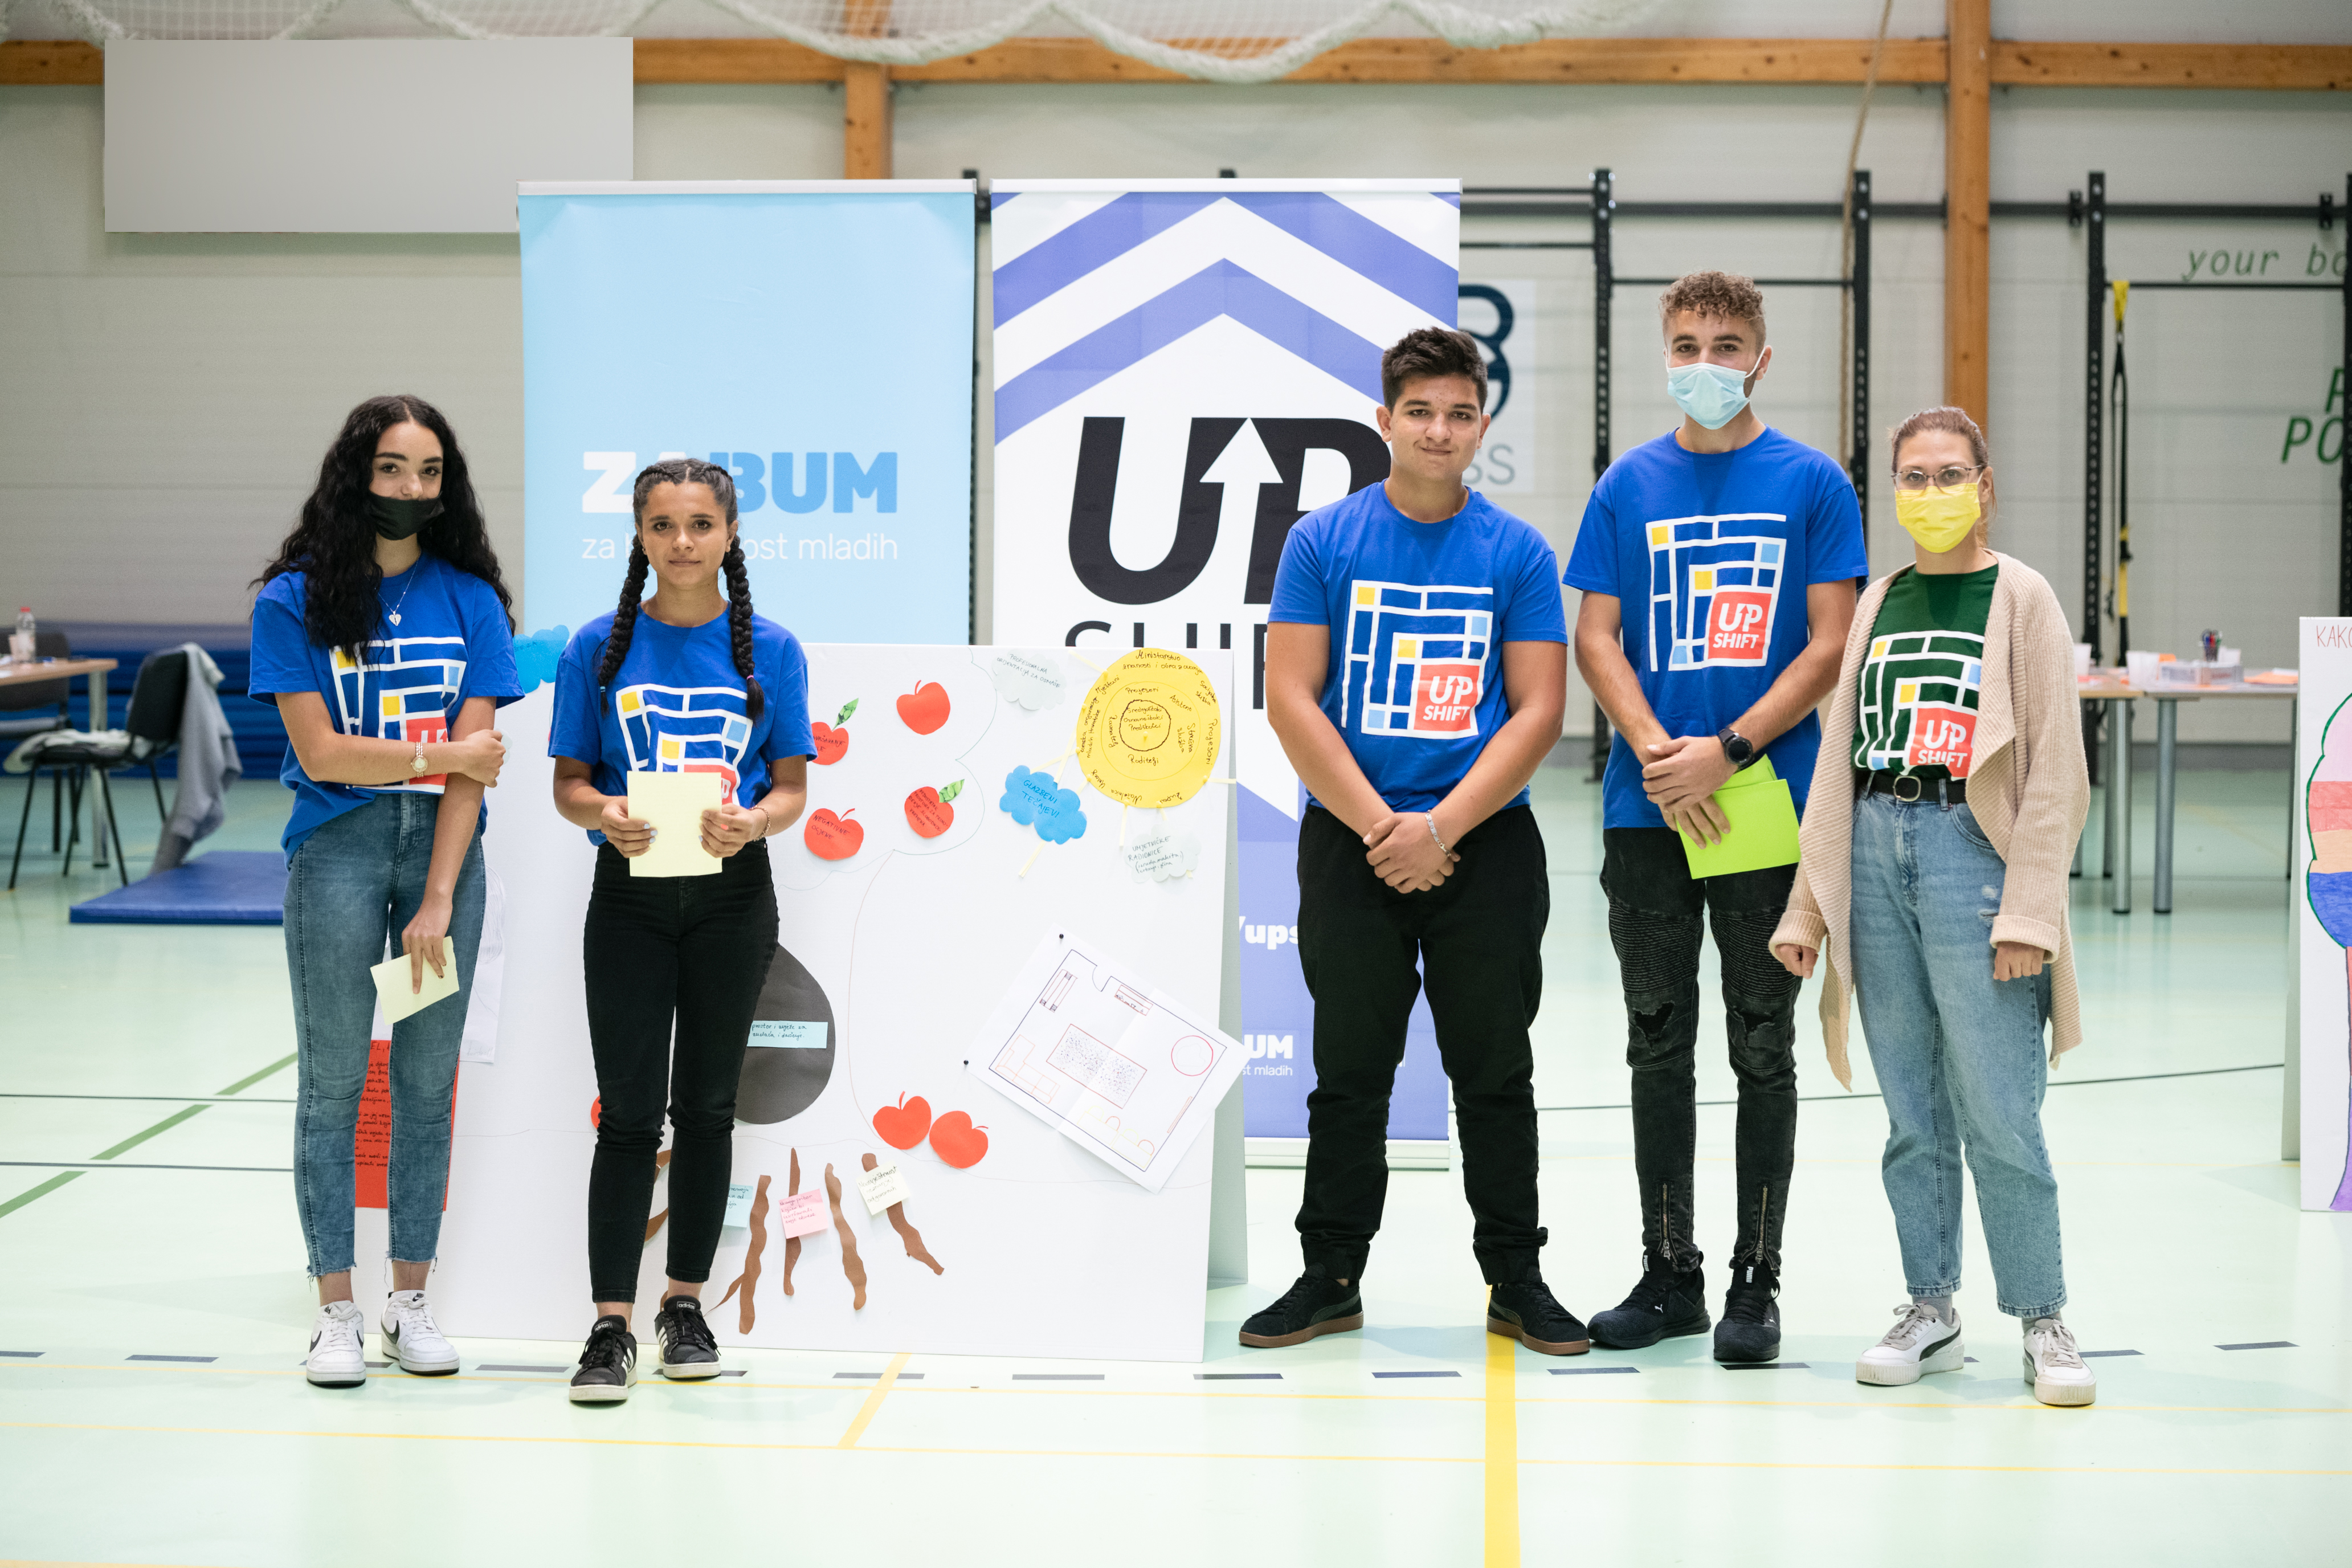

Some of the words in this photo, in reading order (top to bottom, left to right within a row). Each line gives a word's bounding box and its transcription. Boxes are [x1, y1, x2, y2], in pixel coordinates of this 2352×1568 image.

[2182, 248, 2280, 281] your
[582, 451, 898, 514] ZBUM
[1068, 416, 1392, 605] UP
[582, 538, 615, 559] za
[799, 533, 898, 560] mladih
[1717, 602, 1763, 632] UP
[1712, 632, 1759, 649] SHIFT
[1009, 654, 1048, 675] PROFESIONALNA
[1428, 675, 1474, 705] UP
[1422, 705, 1471, 721] SHIFT
[1923, 719, 1967, 750] UP
[1917, 749, 1969, 769] SHIFT
[811, 824, 835, 840] OCJENE
[812, 815, 851, 835] NEGATIVNE
[1132, 835, 1171, 852] UMJETNIČKE
[1128, 846, 1164, 862] RADIONICE
[1254, 1065, 1293, 1076] mladih
[1745, 1265, 1754, 1284] PUMA
